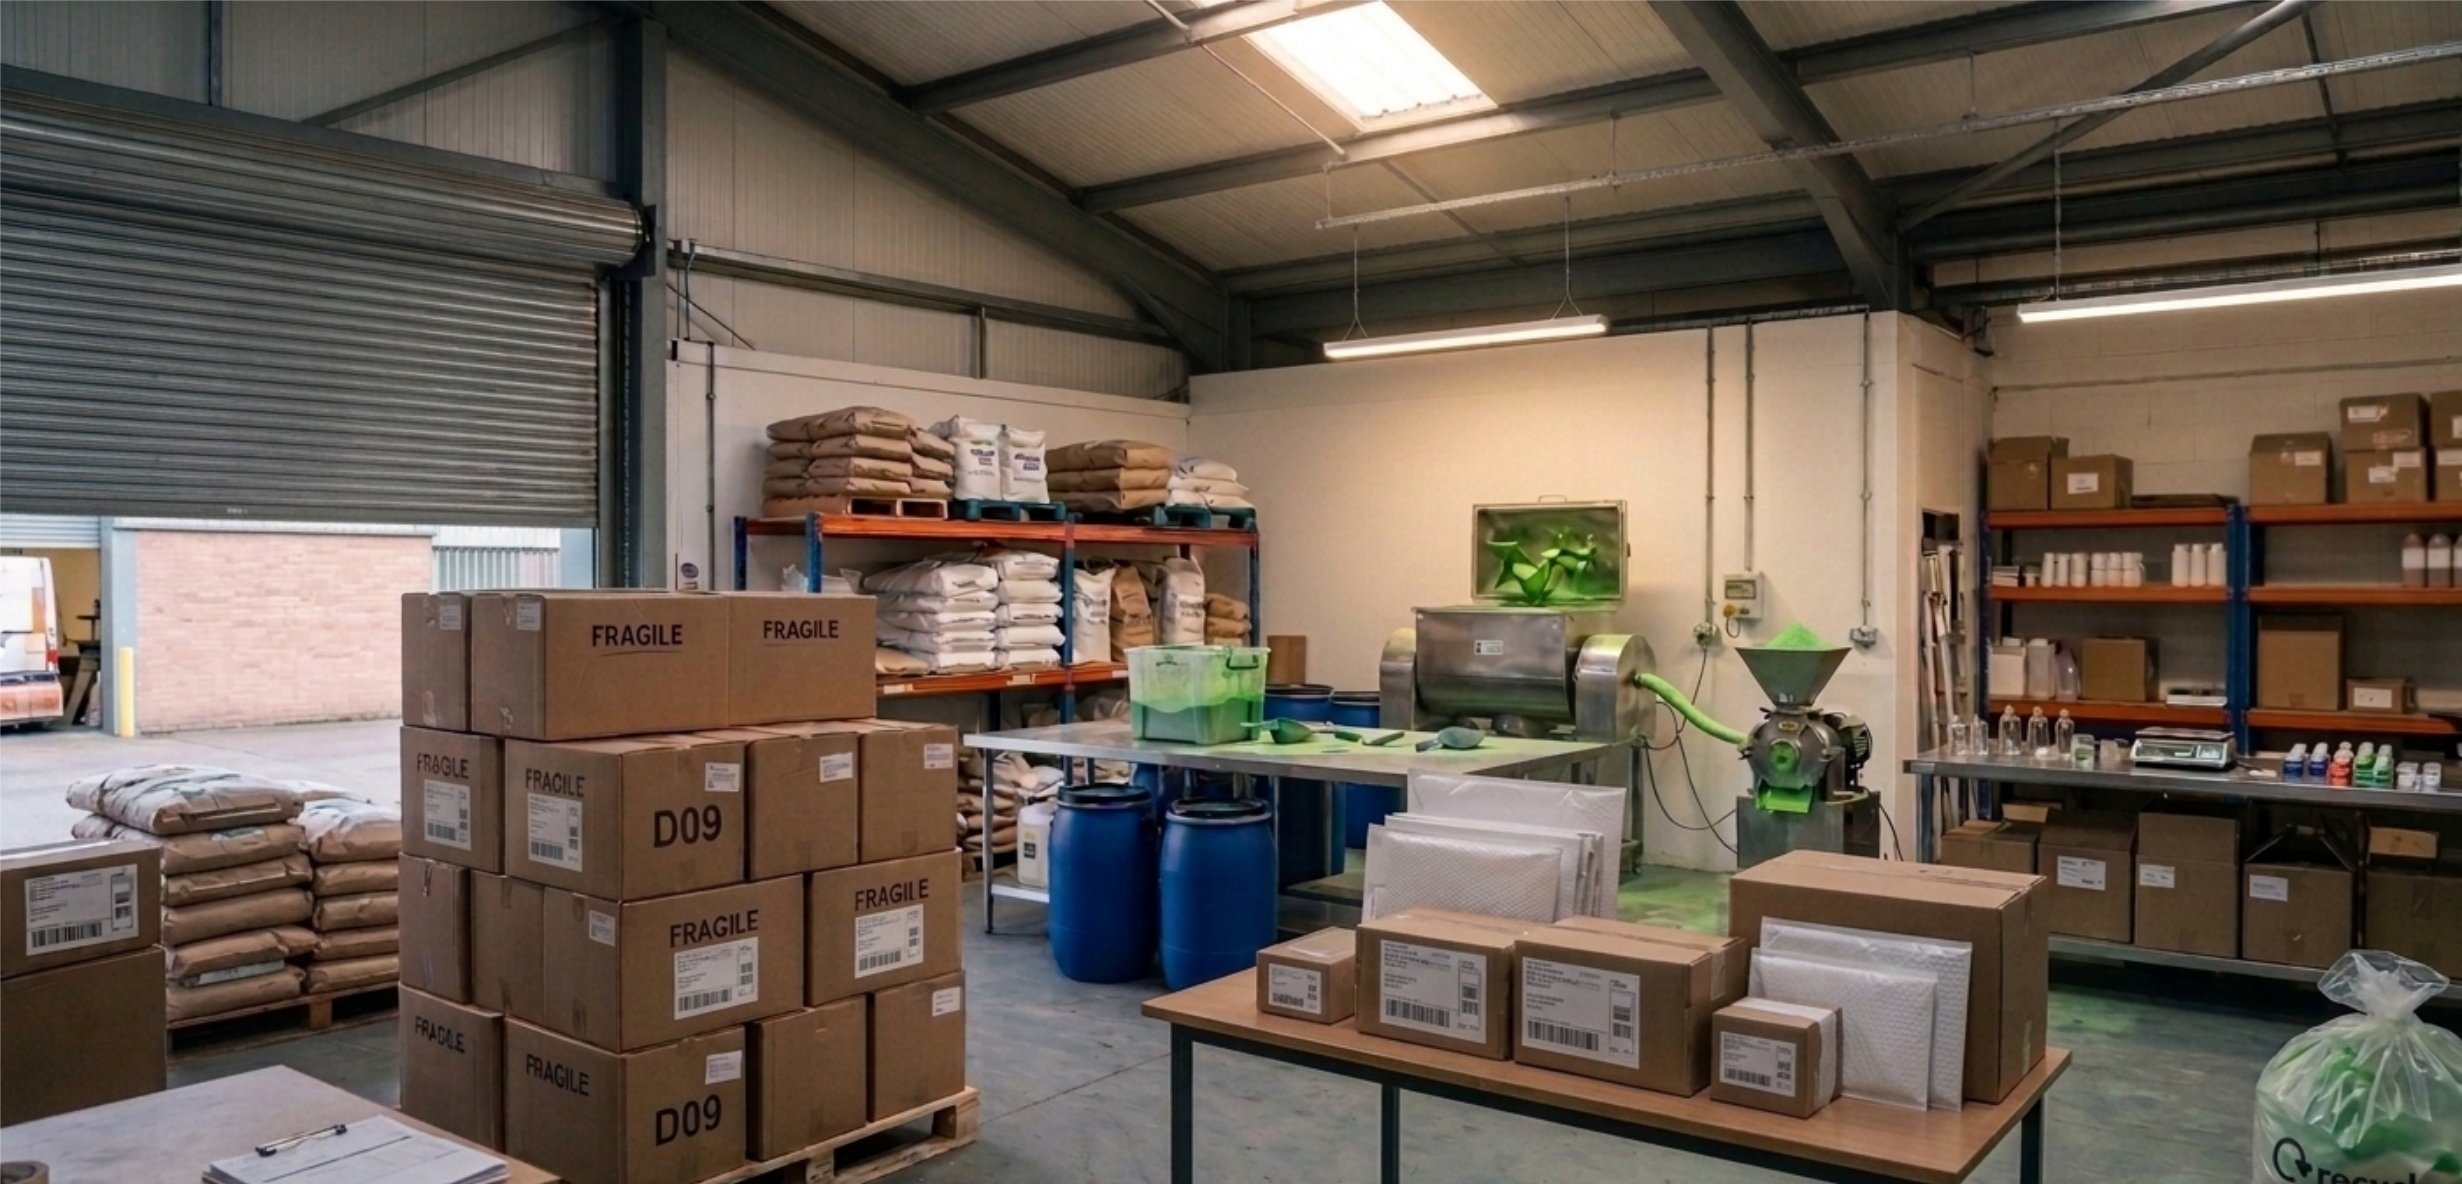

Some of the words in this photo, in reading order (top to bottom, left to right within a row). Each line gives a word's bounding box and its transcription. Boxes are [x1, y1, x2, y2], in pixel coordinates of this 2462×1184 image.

[592, 624, 683, 647] FRAGILE
[763, 620, 839, 640] FRAGILE
[654, 804, 722, 848] D09
[855, 878, 929, 911] FRAGILE
[670, 908, 759, 948] FRAGILE
[526, 1053, 590, 1097] FRAGILE
[656, 1094, 722, 1147] D09
